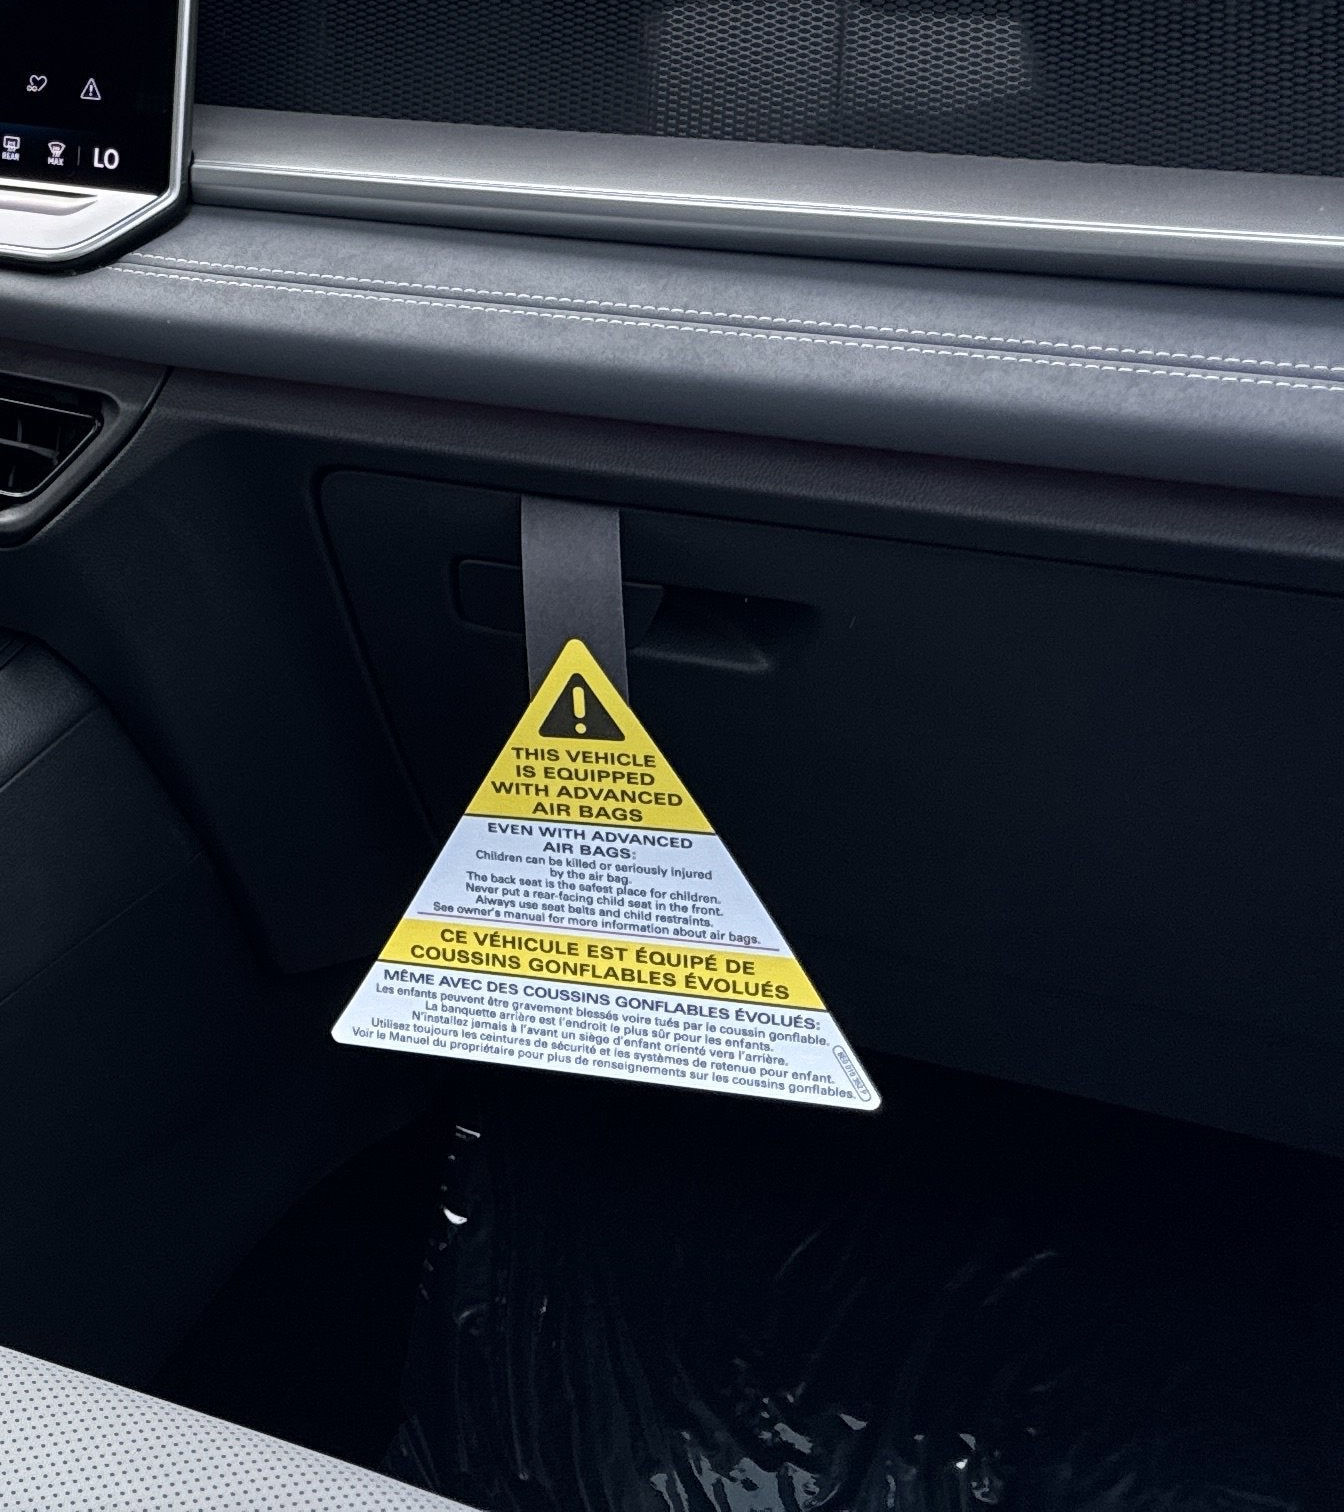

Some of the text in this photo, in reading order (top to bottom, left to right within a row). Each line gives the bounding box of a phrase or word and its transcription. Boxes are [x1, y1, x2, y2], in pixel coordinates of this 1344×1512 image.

[93, 147, 120, 170] LO
[511, 746, 656, 768] THIS VEHICLE
[515, 763, 655, 787] IS EQUIPPED
[490, 780, 683, 807] WITH ADVANCED
[530, 800, 643, 822] AIR BAGS
[487, 821, 693, 849] EVEN WITH ADVANCED
[542, 840, 636, 860] AIR BAGS:
[475, 849, 712, 881] Children can be killed or seriously injured
[549, 866, 632, 887] by the air bag.
[465, 882, 724, 917] Never put a rear-facing child seat in the front.
[468, 871, 721, 904] The back seat is the safest place for children.
[439, 928, 755, 976] CE VÉHICULE EST ÉQUIPÉ DE
[409, 944, 789, 1000] COUSSINS GONFLABLES ÉVOLUÉS
[383, 966, 820, 1031] MÊME AVEC DES COUSSINS GONFLABLES ÉVOLUÉS:
